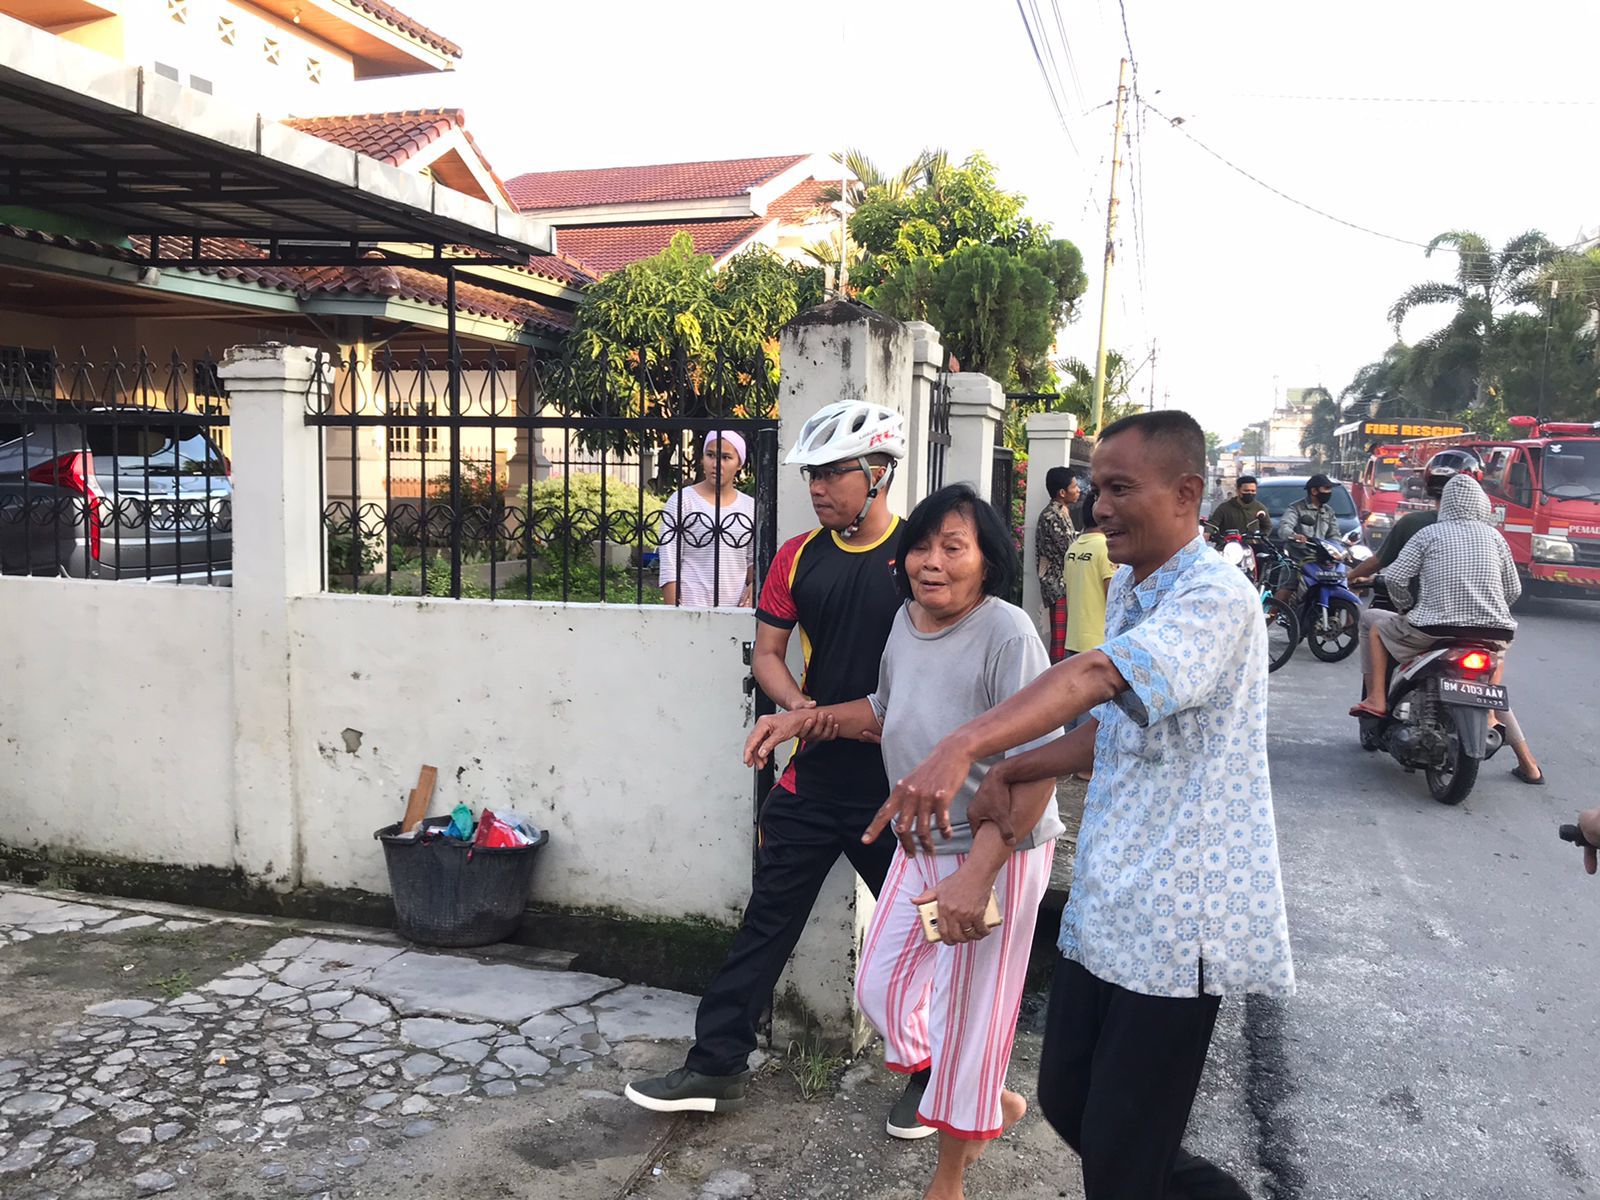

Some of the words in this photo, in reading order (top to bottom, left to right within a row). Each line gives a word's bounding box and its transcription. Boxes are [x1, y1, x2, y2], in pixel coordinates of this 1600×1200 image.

[1365, 423, 1398, 435] FIRE
[1401, 424, 1464, 437] RESCUE
[1444, 681, 1458, 691] BM
[1460, 684, 1483, 695] 4103
